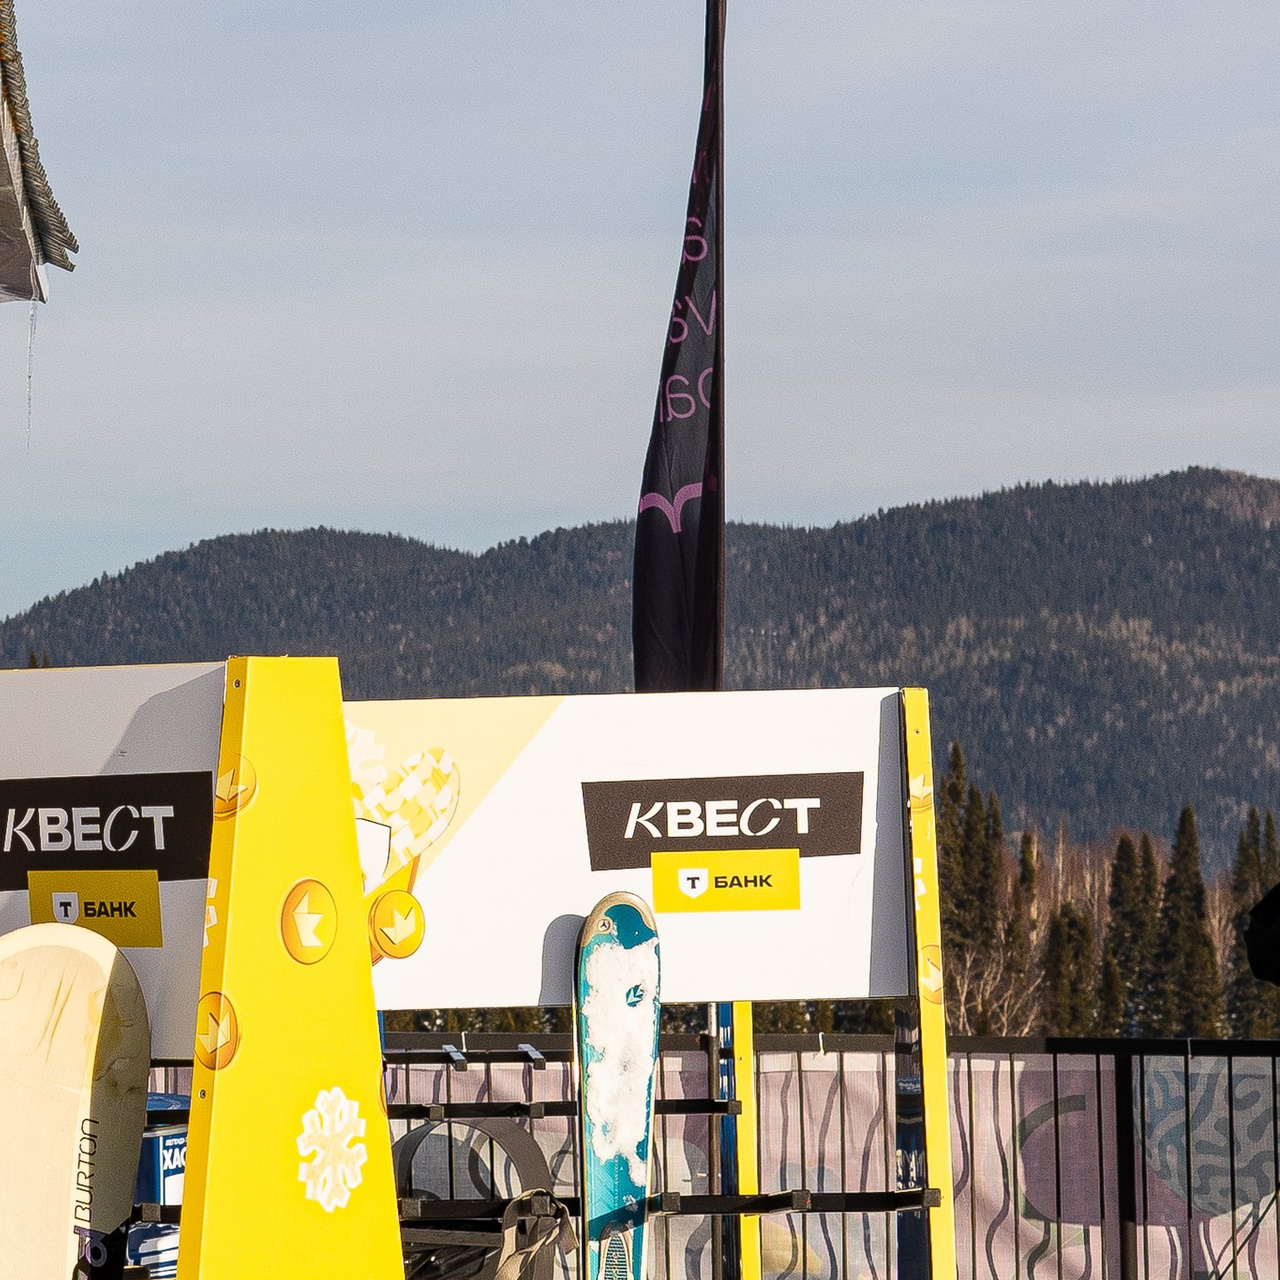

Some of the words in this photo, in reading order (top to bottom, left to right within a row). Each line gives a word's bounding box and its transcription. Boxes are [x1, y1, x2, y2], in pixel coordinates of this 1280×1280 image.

[3, 805, 174, 852] КВЕСТ
[624, 798, 820, 839] КВЕСТ
[714, 874, 773, 889] БАНК
[83, 901, 137, 918] БАНК
[74, 1118, 100, 1224] BURTON
